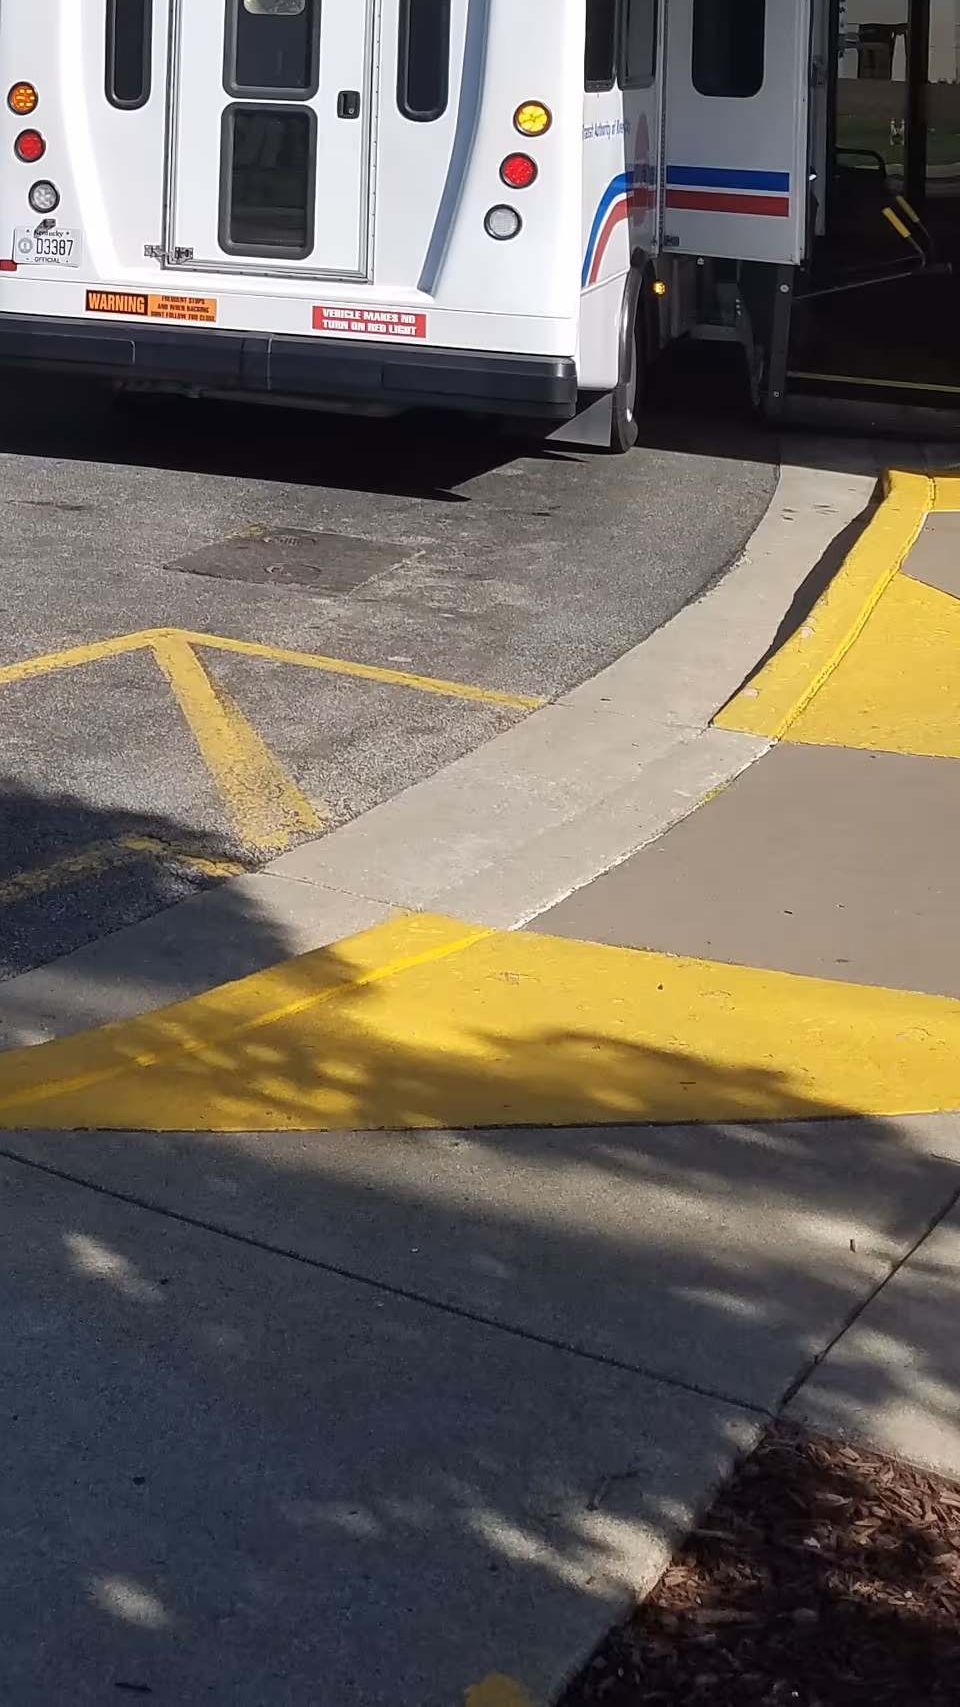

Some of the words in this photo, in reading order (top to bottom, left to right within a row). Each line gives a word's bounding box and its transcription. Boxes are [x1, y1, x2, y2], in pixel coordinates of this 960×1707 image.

[88, 292, 145, 314] WARNING
[161, 295, 187, 303] FREQUENT
[188, 297, 205, 305] STOPS
[187, 305, 210, 313] BACKING
[165, 312, 187, 320] FOLLOW
[188, 313, 199, 321] TOO
[322, 308, 361, 320] VEHICLE
[363, 311, 399, 323] MAKES
[401, 314, 416, 324] NO
[322, 319, 349, 330] TURN
[351, 321, 365, 331] ON
[368, 323, 387, 333] RED
[388, 325, 417, 336] LIGHT
